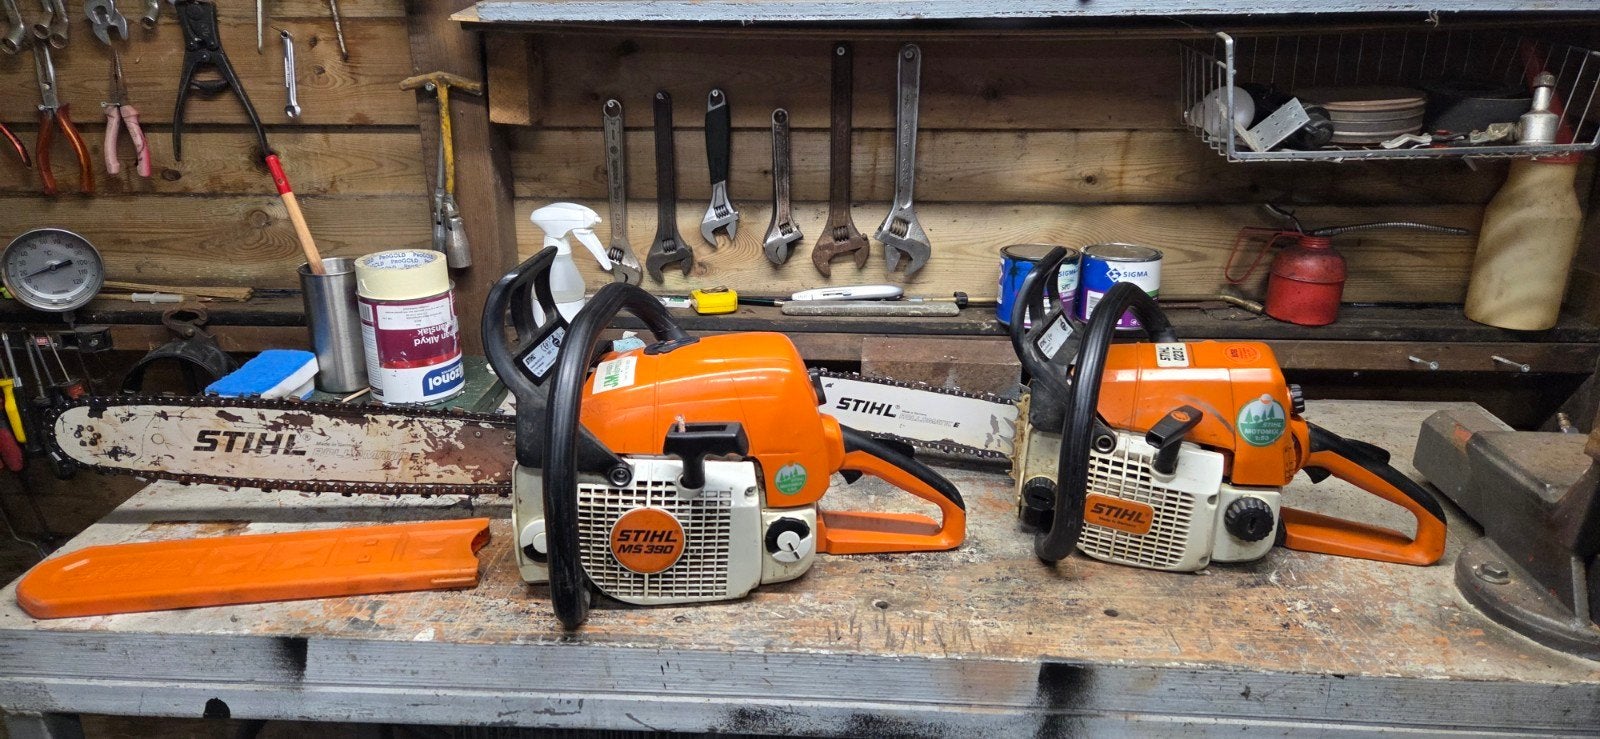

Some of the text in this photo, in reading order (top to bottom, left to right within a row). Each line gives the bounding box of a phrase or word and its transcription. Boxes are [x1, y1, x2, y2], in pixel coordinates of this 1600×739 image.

[414, 335, 440, 347] Alkyd
[836, 397, 897, 418] STIHL
[193, 429, 307, 456] STIHL
[1090, 503, 1146, 524] STIHL
[617, 530, 678, 542] STIHL
[618, 544, 674, 554] MS 390
